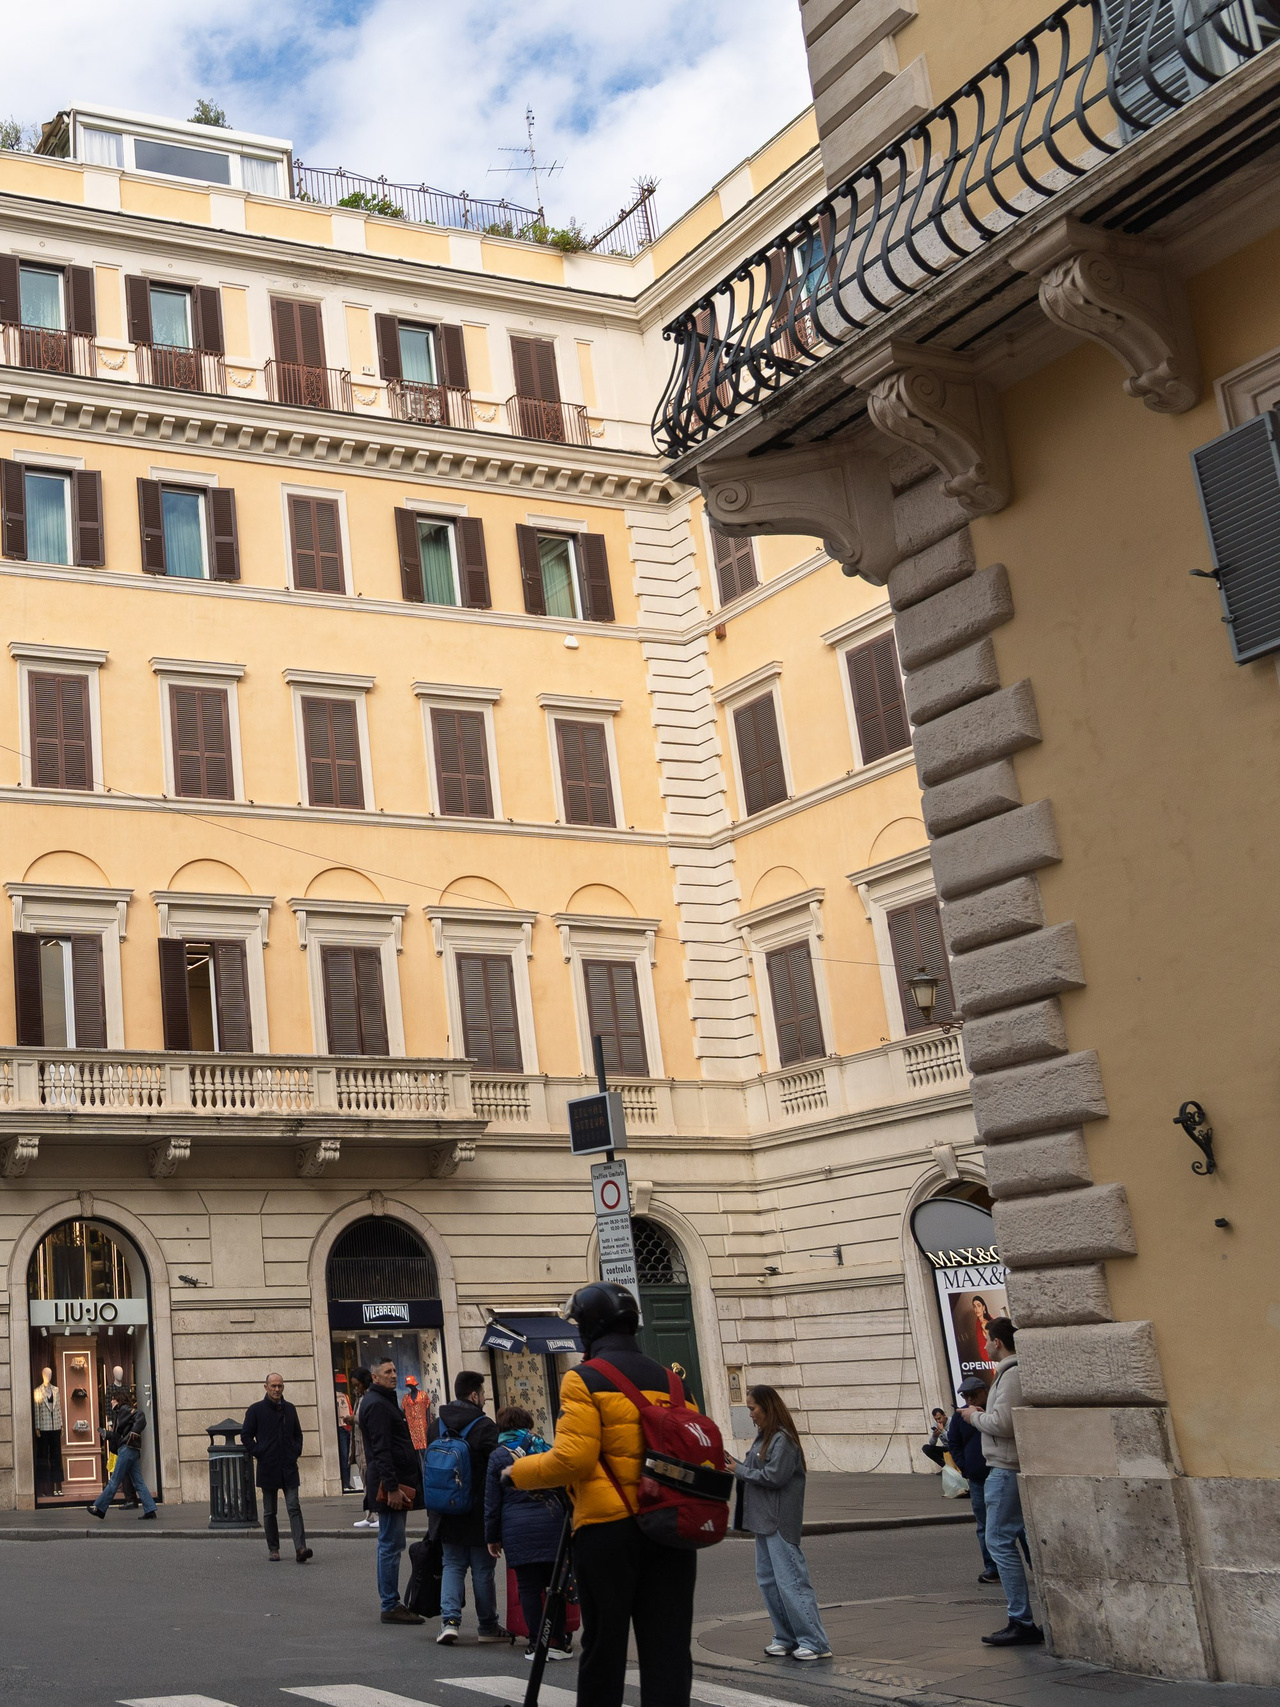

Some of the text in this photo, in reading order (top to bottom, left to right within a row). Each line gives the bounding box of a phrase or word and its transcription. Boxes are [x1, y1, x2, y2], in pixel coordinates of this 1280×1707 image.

[593, 1172, 608, 1180] traffico
[606, 1264, 631, 1275] controllo
[943, 1265, 1007, 1290] MAX&
[364, 1305, 408, 1321] VILEBREQUIN
